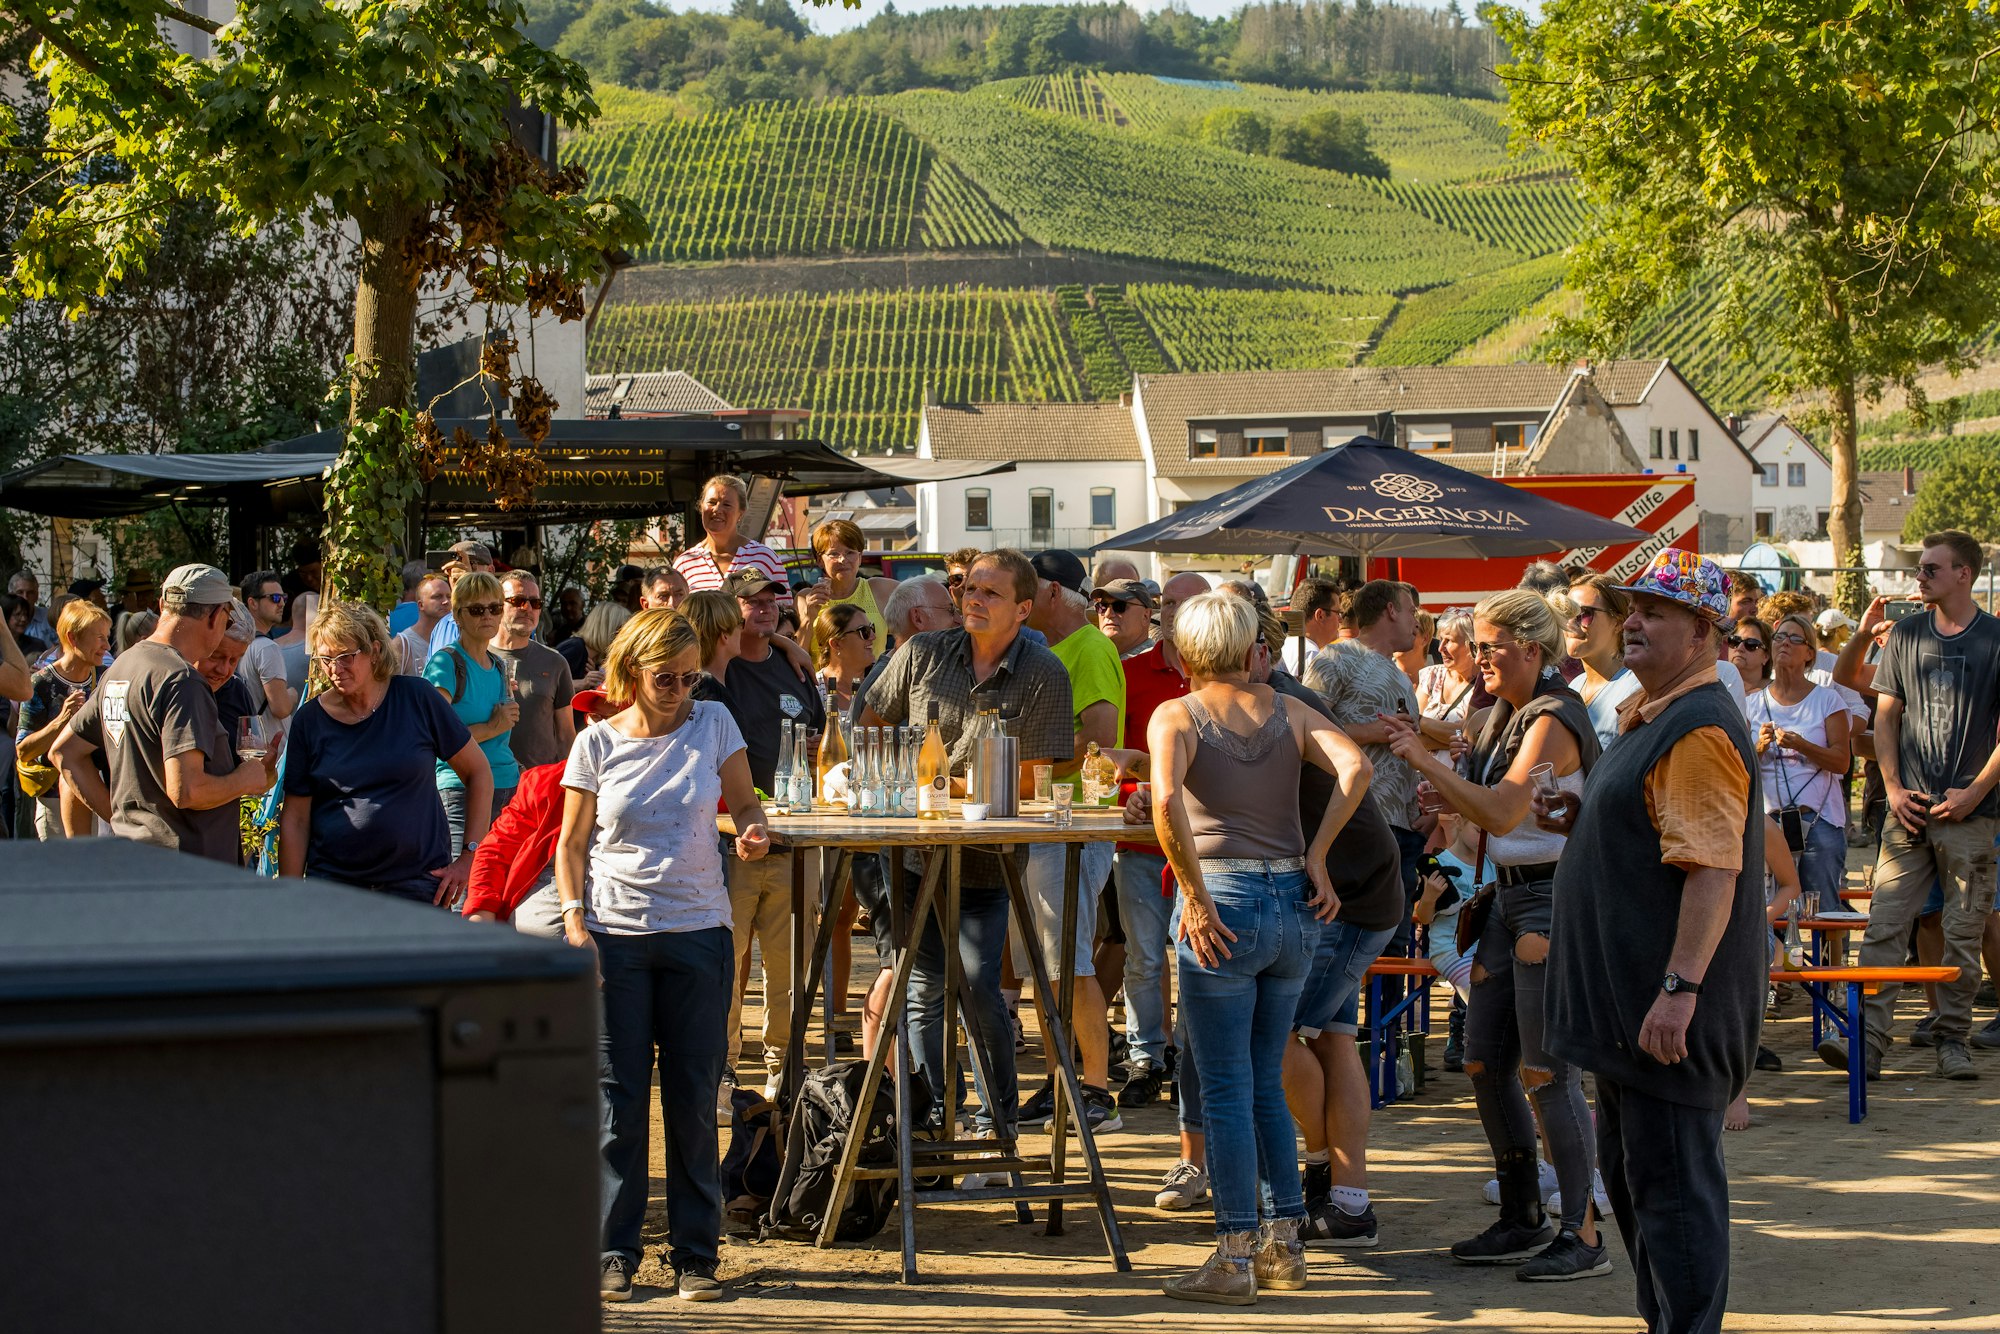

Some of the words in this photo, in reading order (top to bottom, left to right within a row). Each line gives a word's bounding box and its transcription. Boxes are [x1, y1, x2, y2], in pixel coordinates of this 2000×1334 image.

[1321, 505, 1531, 527] DAGERNOVA
[1625, 490, 1664, 524] Hilfe
[1384, 520, 1474, 530] WEINMANUFAKTUR
